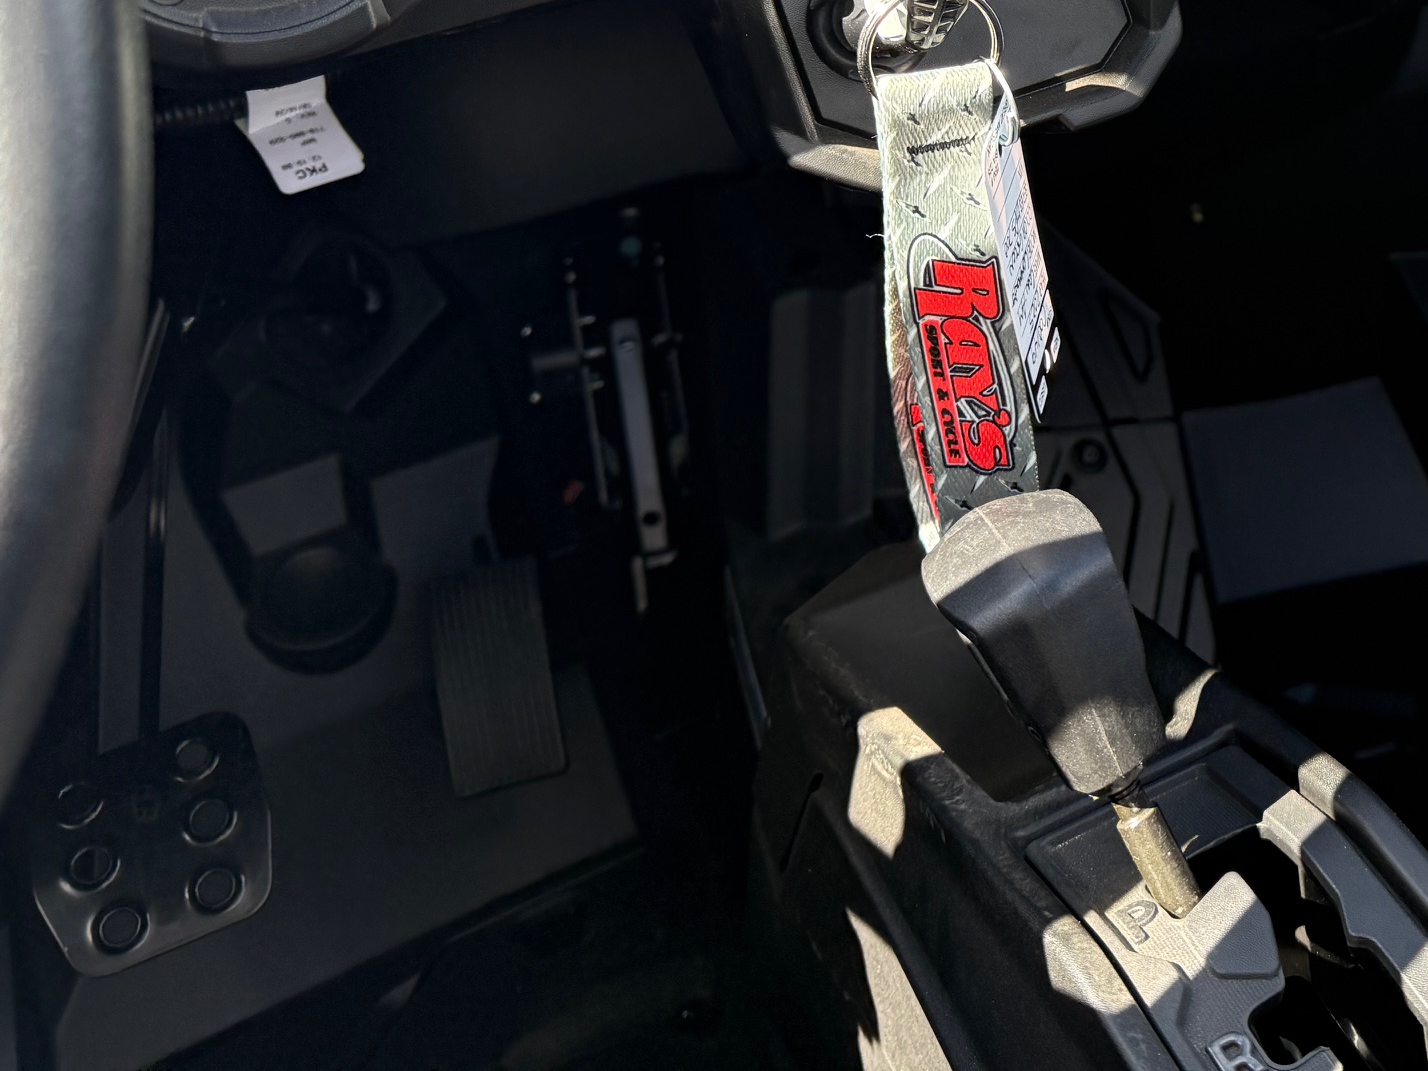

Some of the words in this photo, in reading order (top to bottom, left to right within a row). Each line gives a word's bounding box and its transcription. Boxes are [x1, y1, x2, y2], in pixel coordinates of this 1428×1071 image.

[924, 324, 946, 380] SPORT
[937, 387, 949, 401] &
[941, 408, 961, 459] CYCLE
[1115, 899, 1159, 947] P
